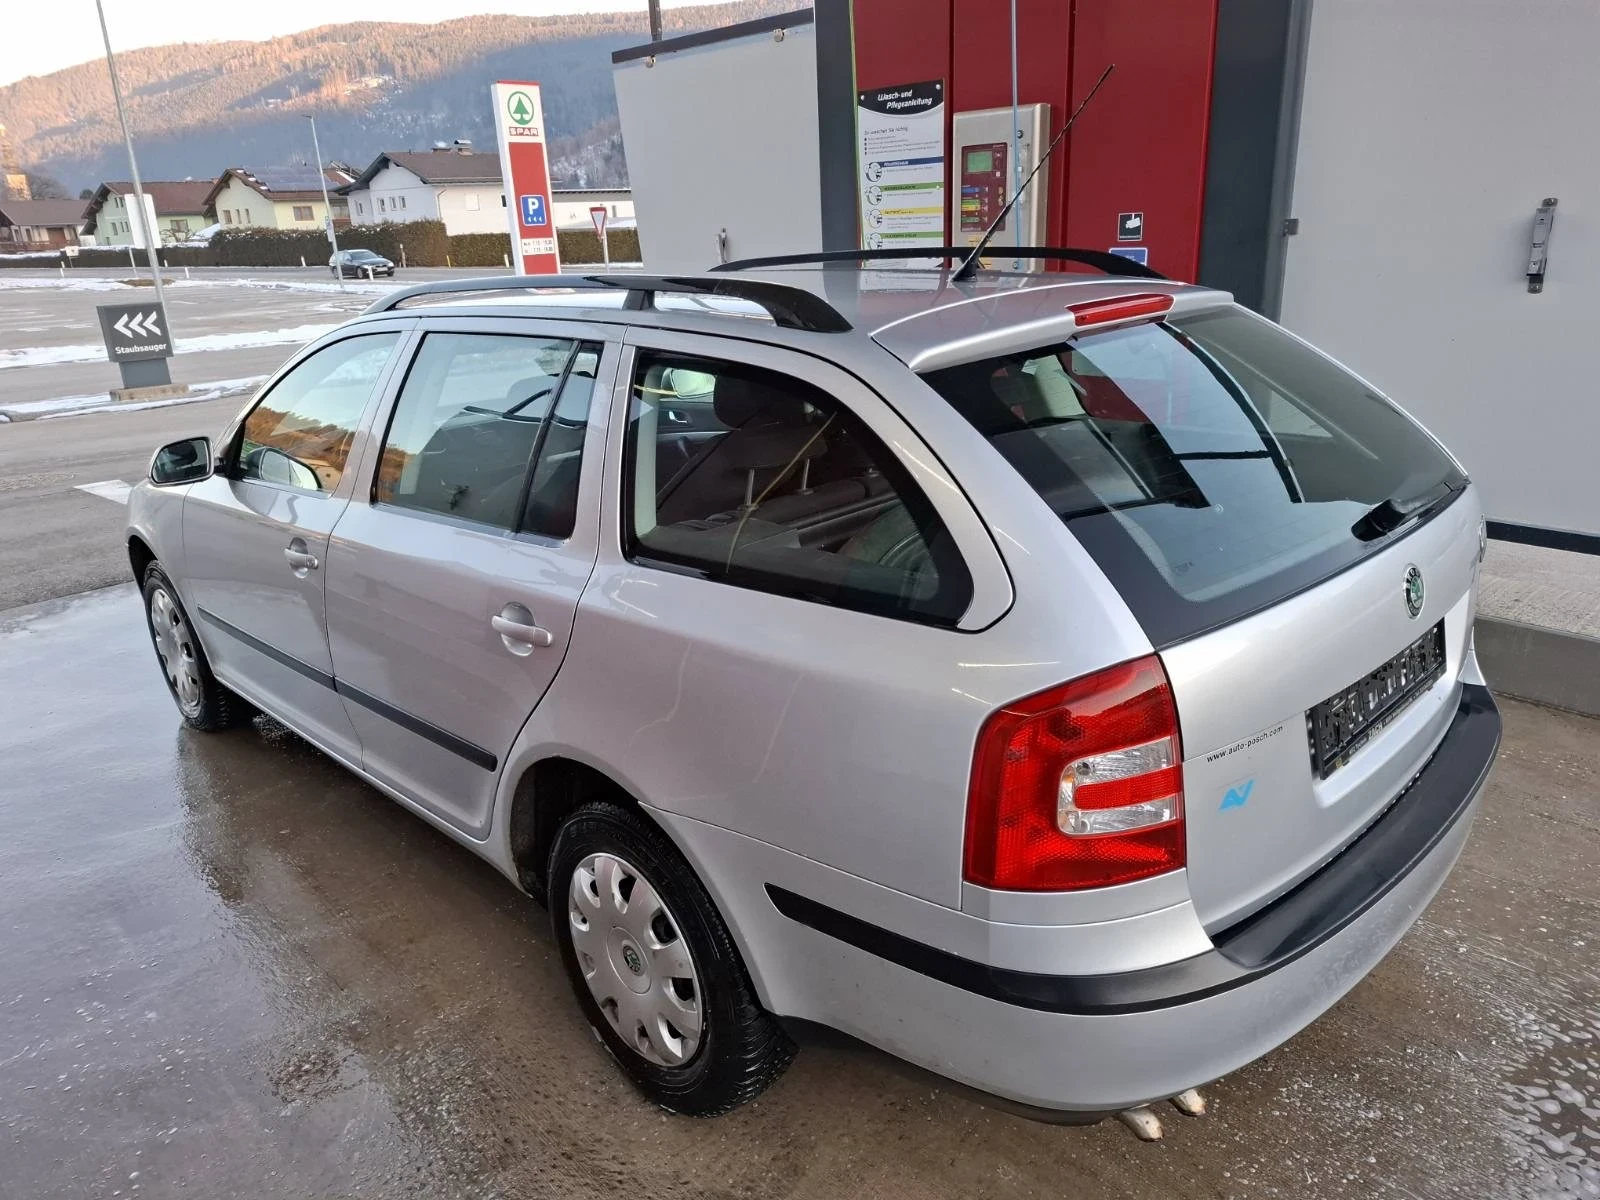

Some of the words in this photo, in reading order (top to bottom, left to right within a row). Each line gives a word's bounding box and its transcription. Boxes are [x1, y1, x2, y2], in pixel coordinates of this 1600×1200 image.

[901, 89, 913, 98] und
[886, 98, 933, 109] Pflegeanleitung
[509, 126, 538, 137] SPAR
[528, 198, 539, 215] P
[115, 343, 167, 354] Staubsauger
[1206, 725, 1284, 763] www.auto-posch.com
